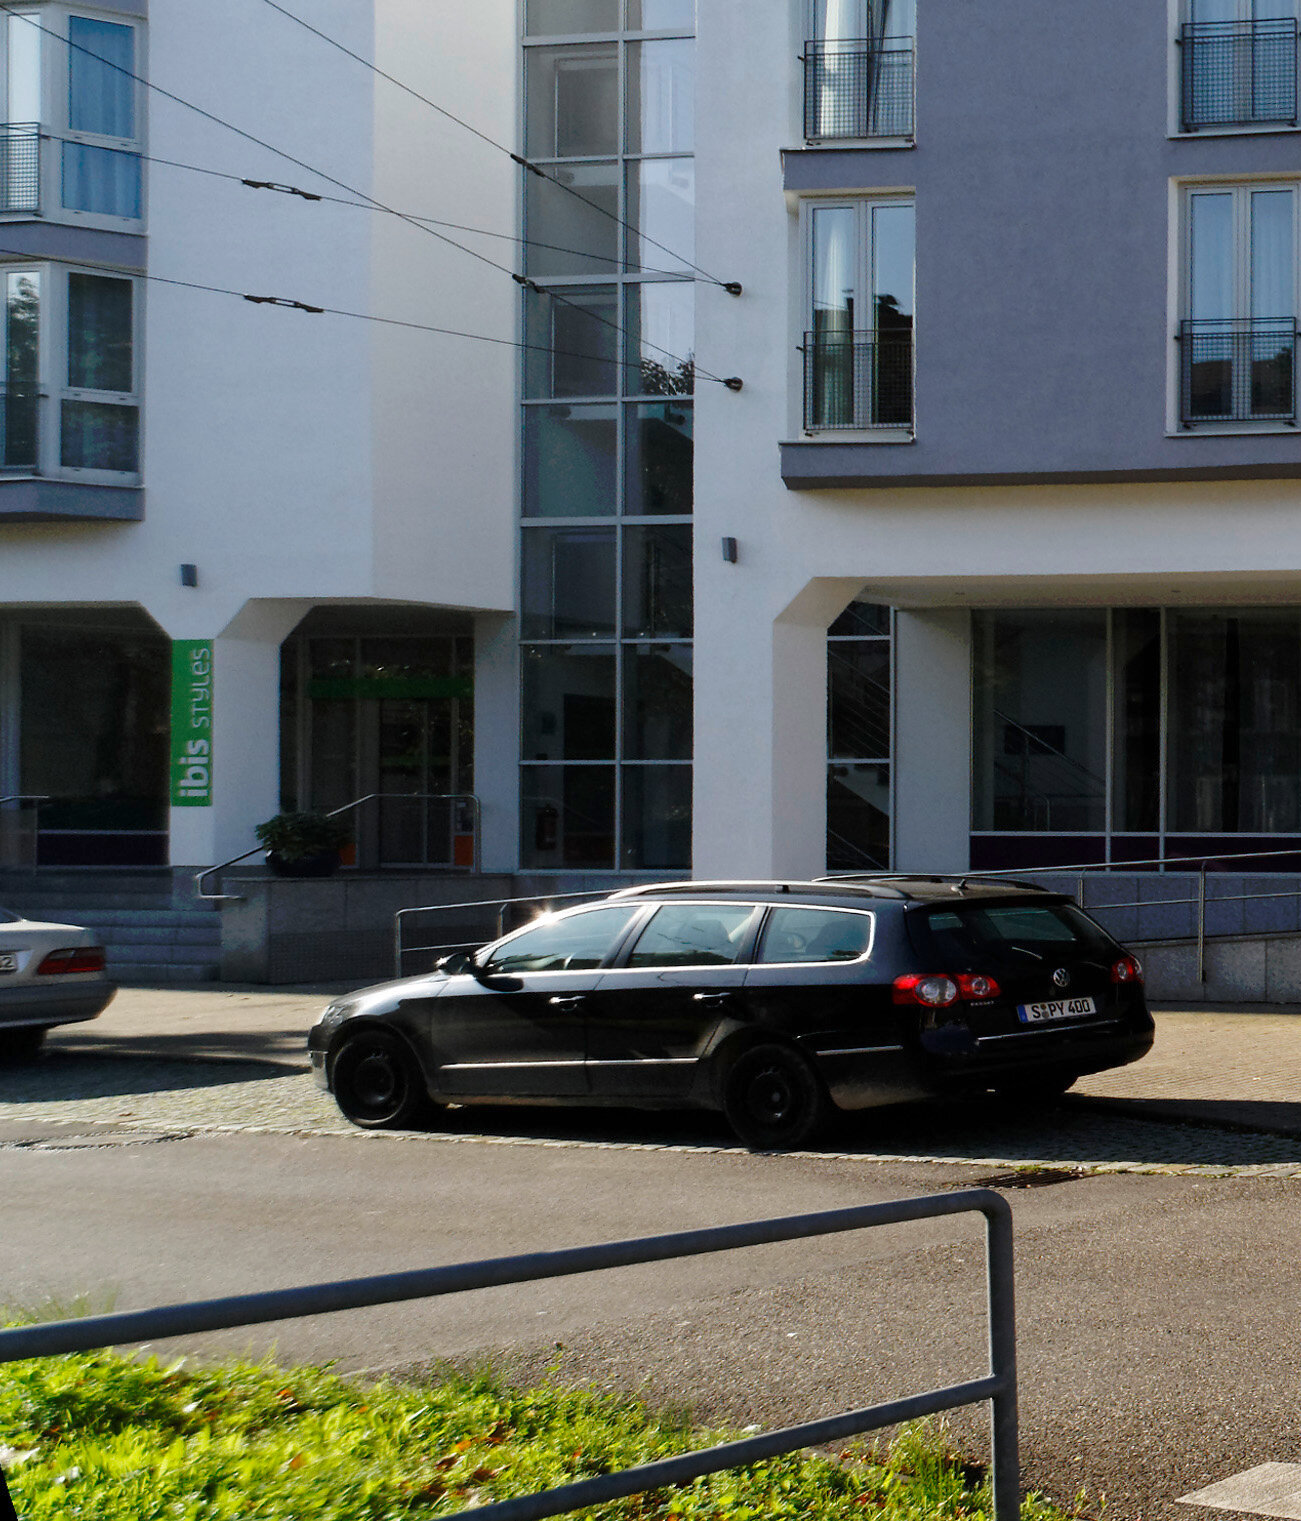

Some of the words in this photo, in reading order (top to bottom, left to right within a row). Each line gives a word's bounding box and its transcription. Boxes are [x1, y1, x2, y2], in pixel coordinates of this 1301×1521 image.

[179, 738, 209, 797] ibis
[1031, 1005, 1041, 1018] S
[1048, 1001, 1064, 1016] PY
[1068, 999, 1091, 1013] 400
